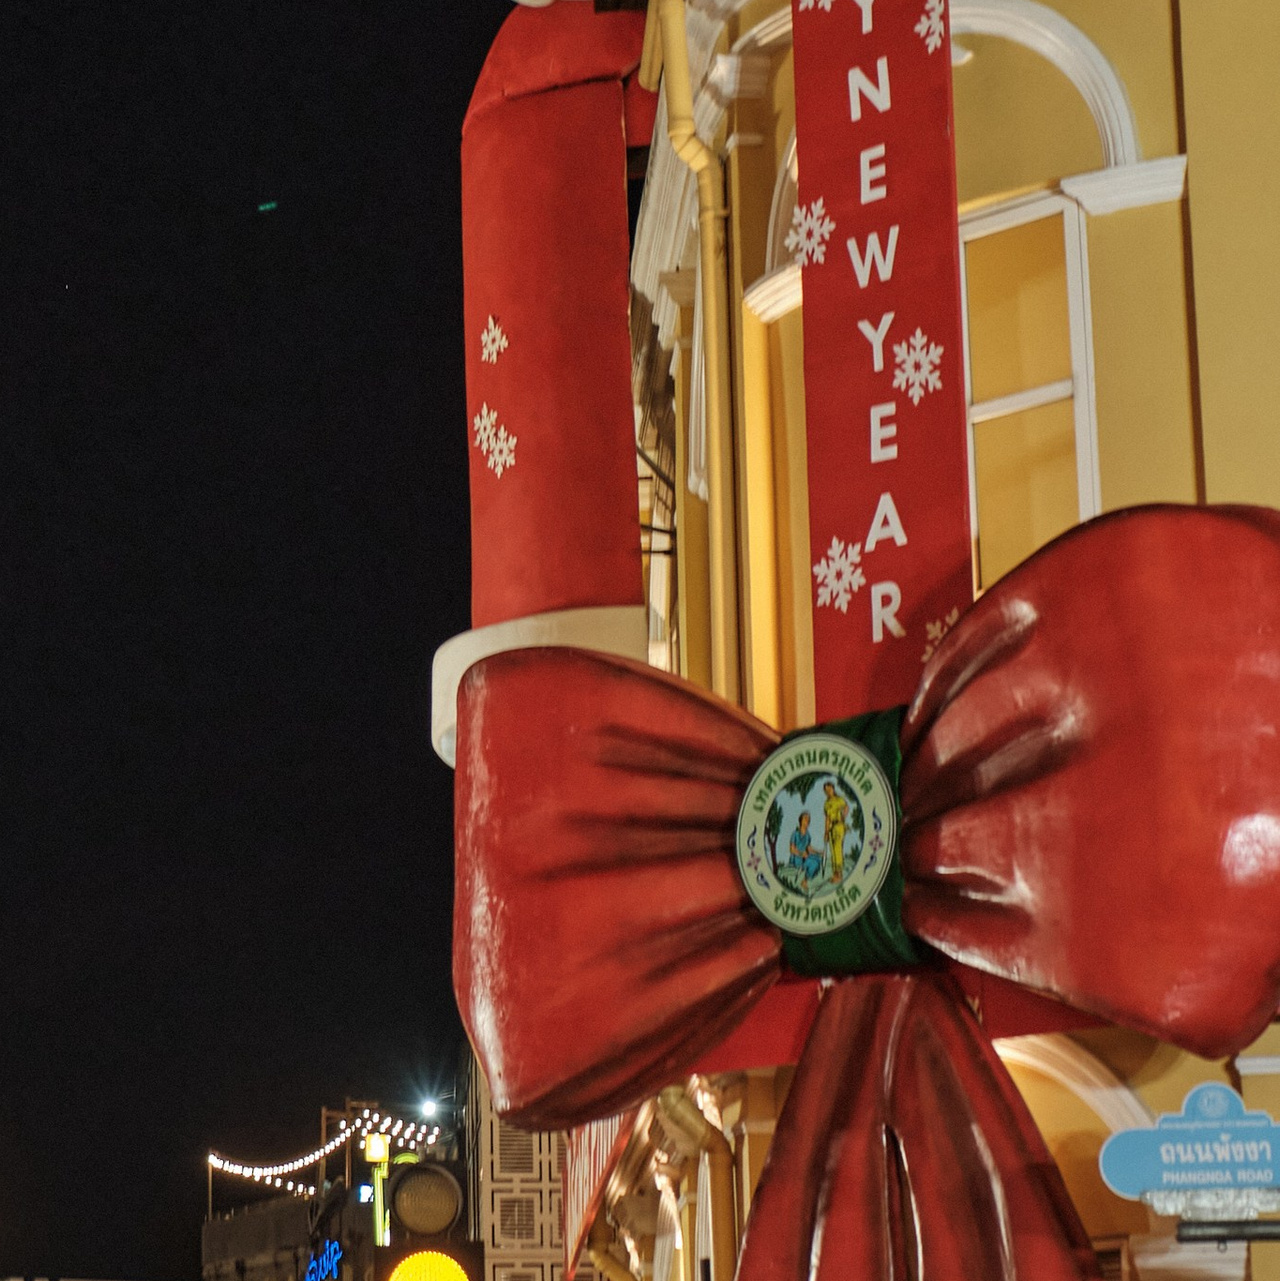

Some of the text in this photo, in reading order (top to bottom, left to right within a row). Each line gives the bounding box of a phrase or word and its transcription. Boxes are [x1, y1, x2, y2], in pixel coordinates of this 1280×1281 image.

[753, 747, 874, 813] เทศบาลนครภูเก็ต
[773, 884, 862, 927] จังหวัดภูเก็ต
[1160, 1133, 1272, 1164] ถนนพังงา
[1237, 1169, 1273, 1183] ROAD
